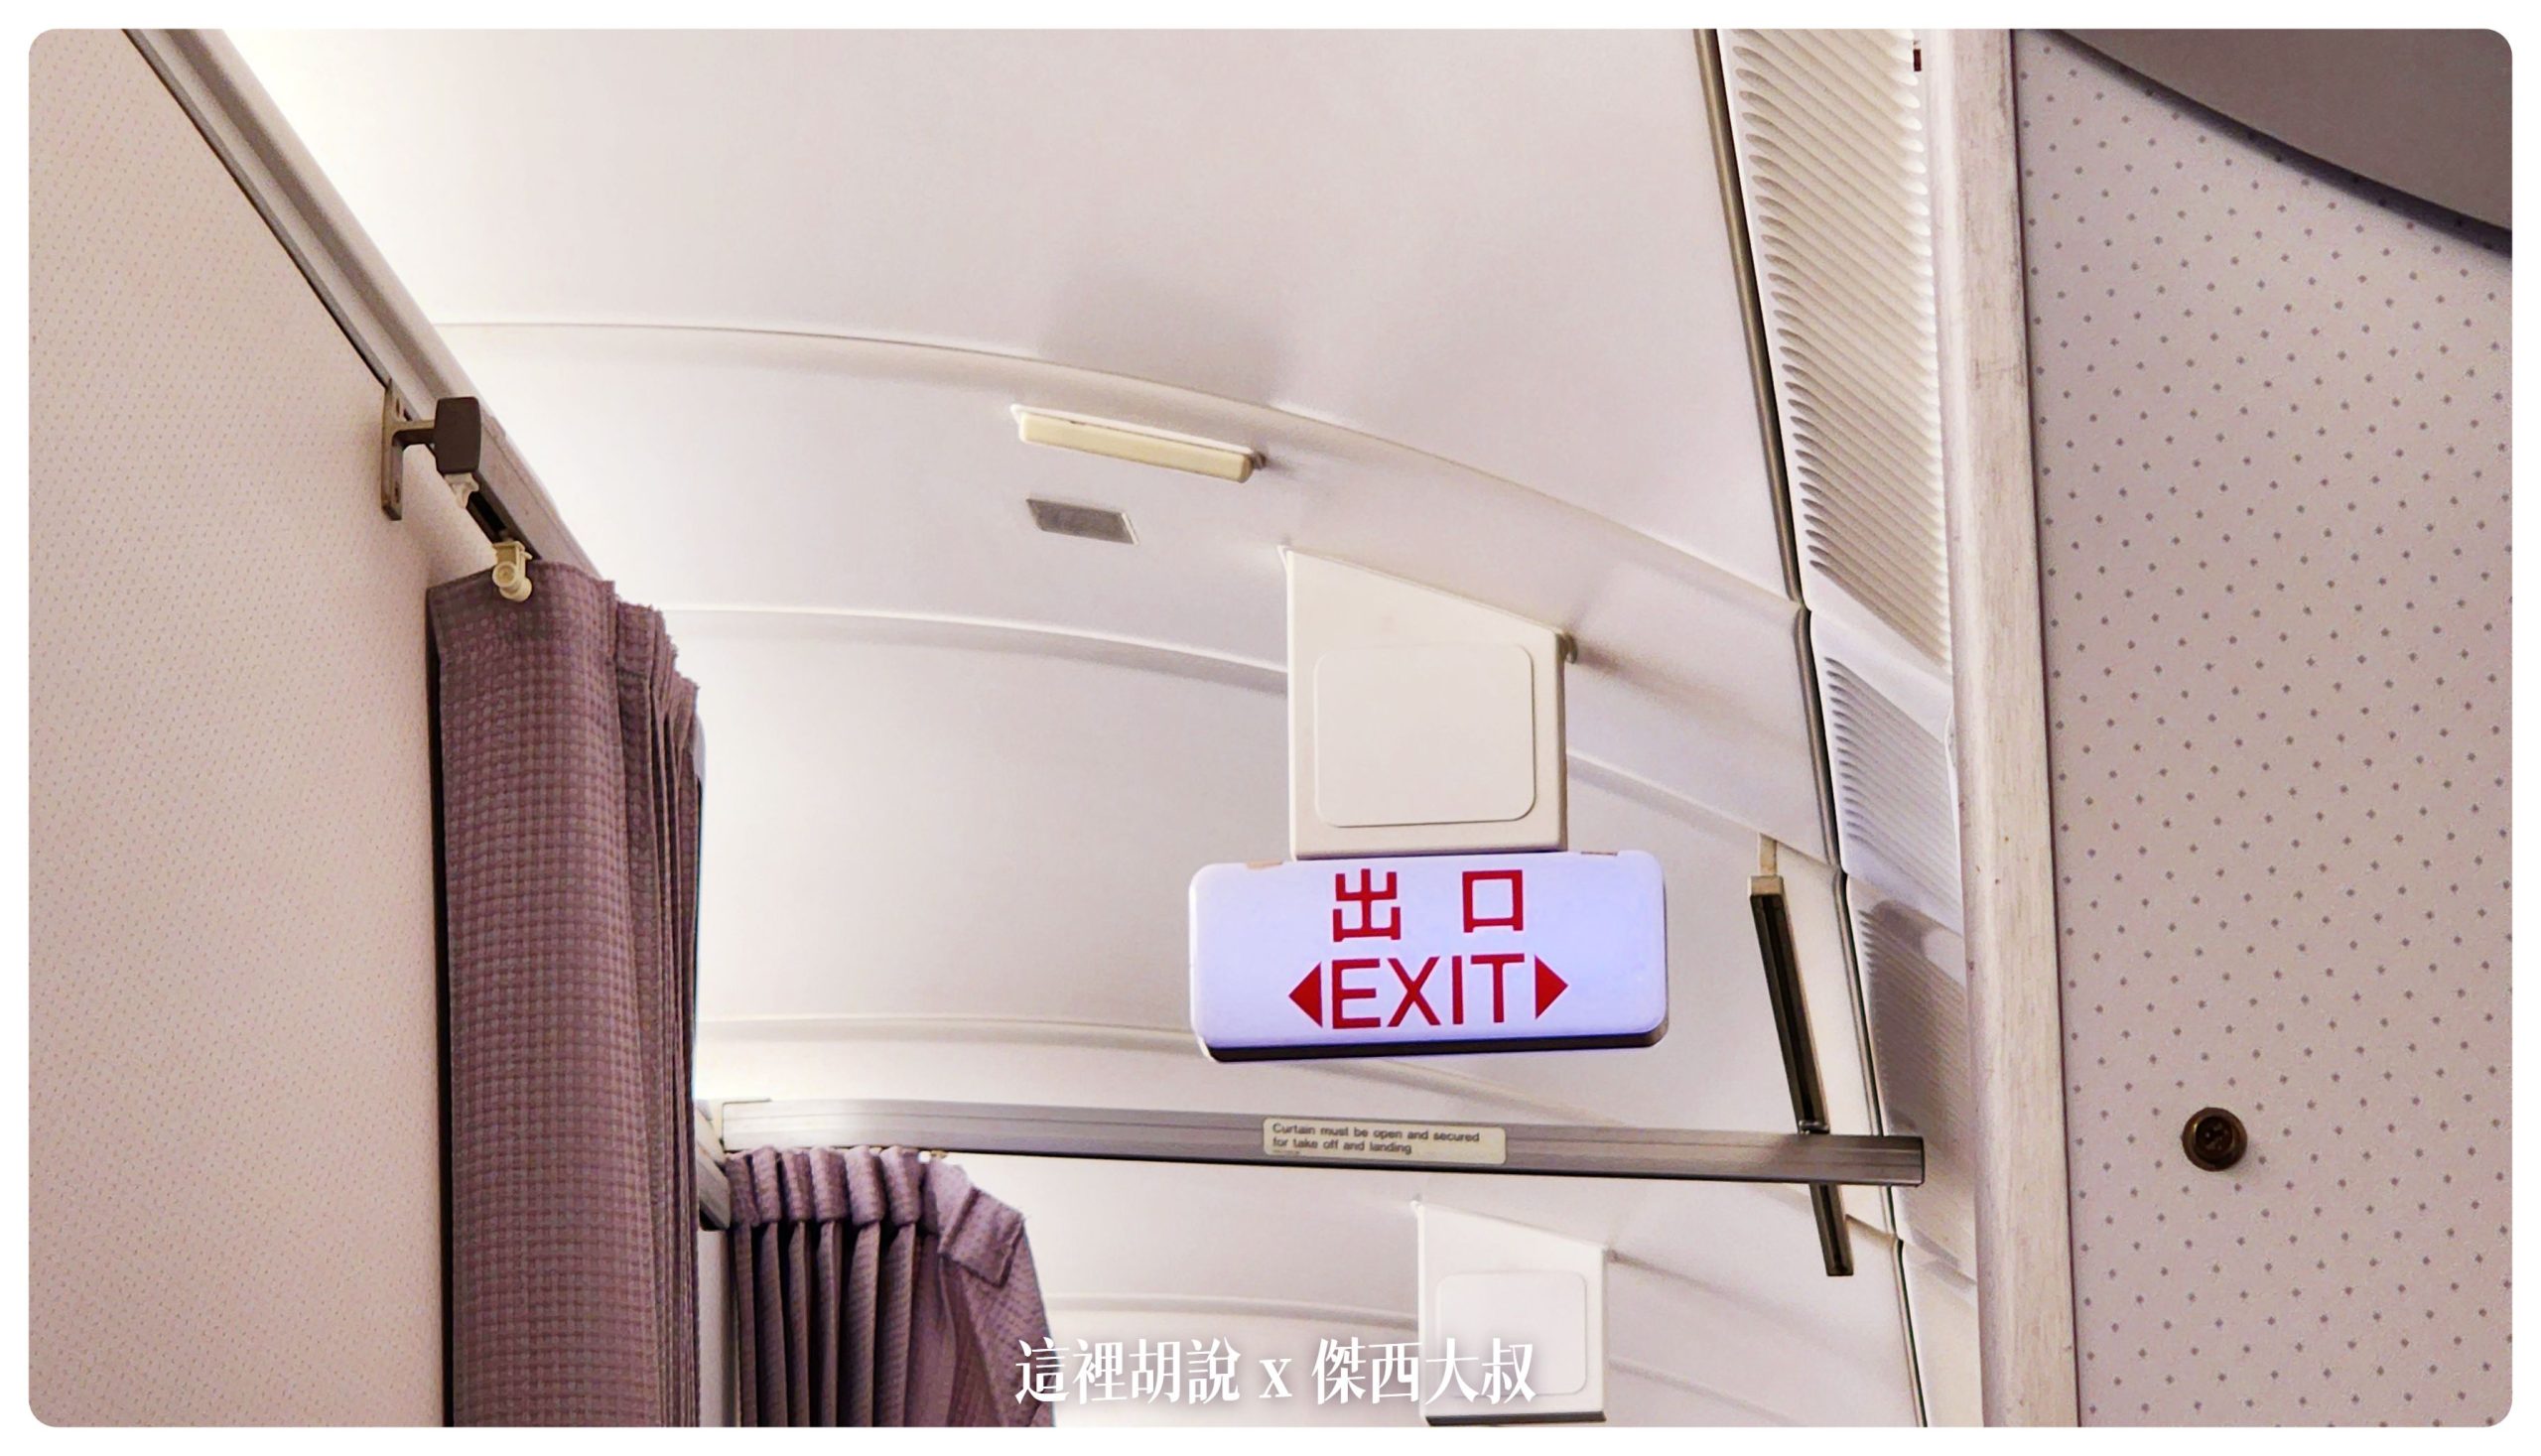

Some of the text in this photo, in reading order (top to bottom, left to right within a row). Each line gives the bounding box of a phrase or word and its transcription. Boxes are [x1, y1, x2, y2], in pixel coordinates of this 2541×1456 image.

[1332, 868, 1525, 942] 出口
[1331, 953, 1526, 1030] EXIT
[1271, 1122, 1480, 1142] Curtain must be open and secured
[1272, 1136, 1412, 1154] for take off and landing
